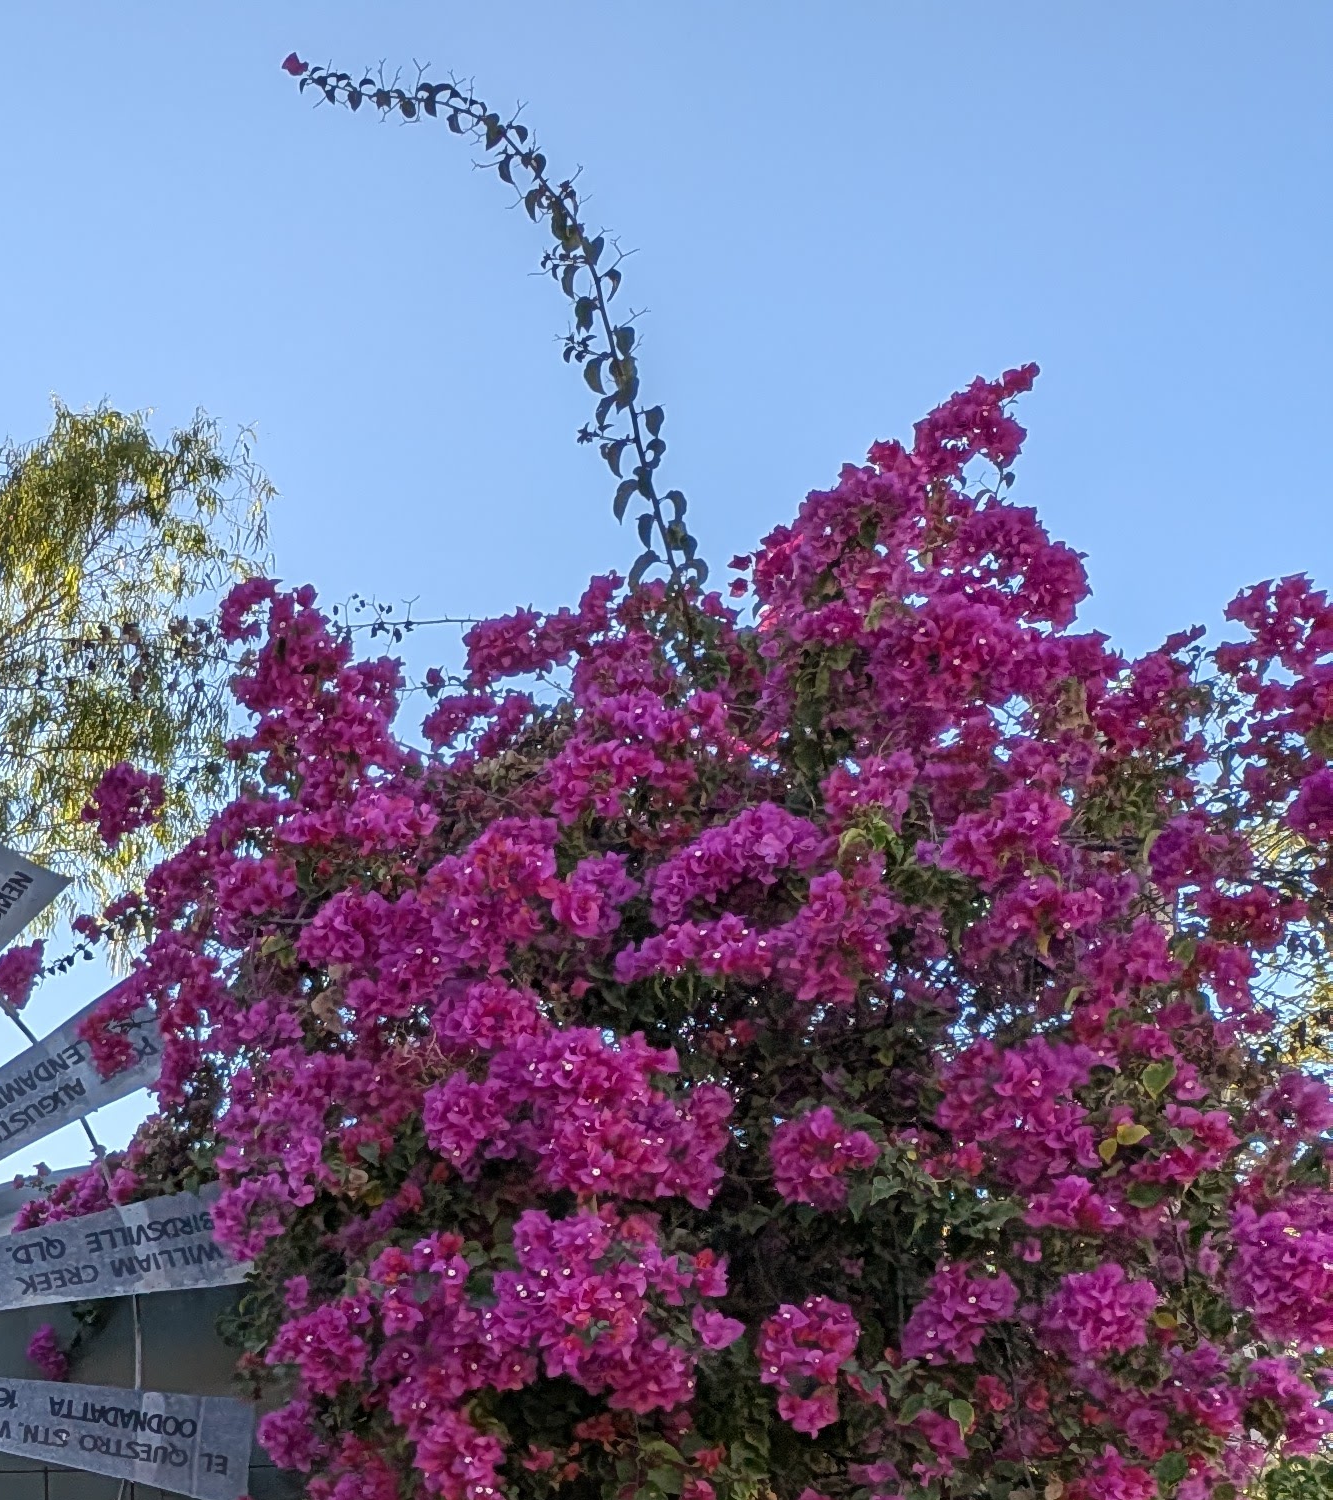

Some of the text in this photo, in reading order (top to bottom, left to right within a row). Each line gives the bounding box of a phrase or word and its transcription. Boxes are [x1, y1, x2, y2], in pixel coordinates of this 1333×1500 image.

[86, 1209, 215, 1252] BIRDSVILLE
[5, 1236, 66, 1264] QLD.
[110, 1241, 224, 1276] WILLIAM
[16, 1264, 99, 1295] CREEK
[49, 1396, 197, 1438] OODNADATTA
[79, 1434, 189, 1467] QUESTRO
[200, 1451, 228, 1475] EL
